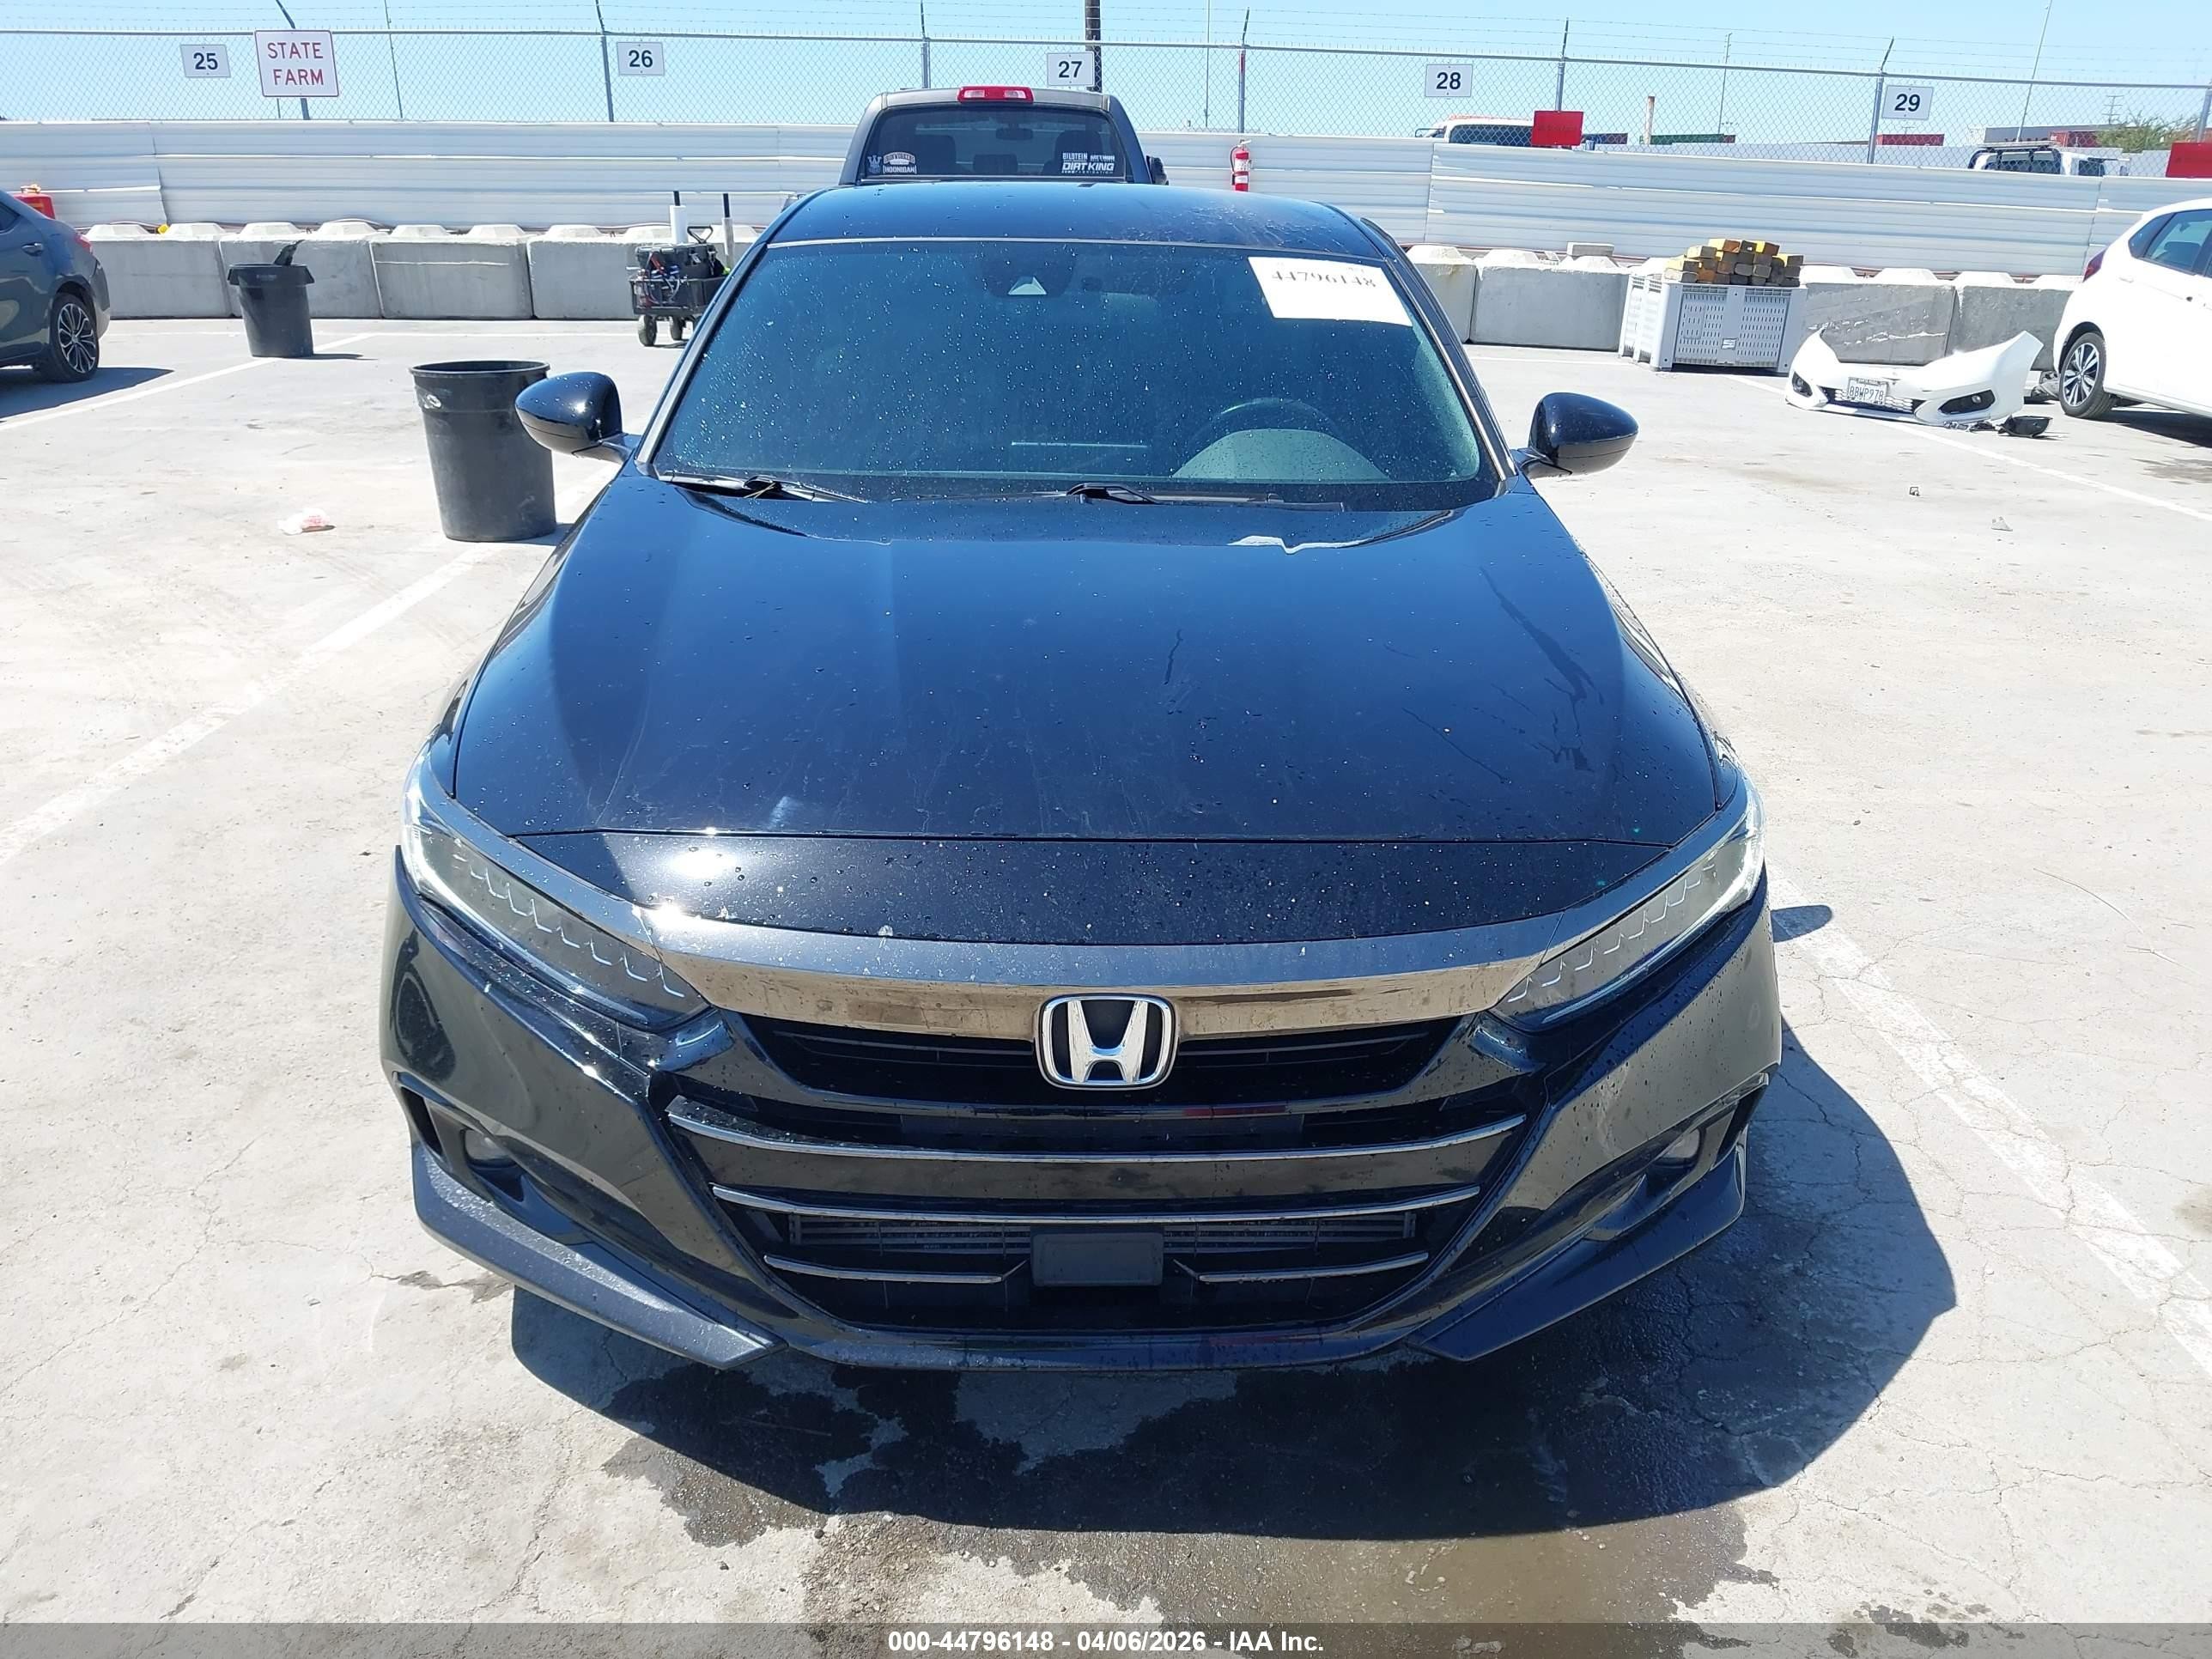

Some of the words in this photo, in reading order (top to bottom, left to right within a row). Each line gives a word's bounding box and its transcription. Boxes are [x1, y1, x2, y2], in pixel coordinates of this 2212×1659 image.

[267, 42, 324, 59] STATE
[629, 50, 653, 68] 26
[193, 52, 218, 70] 25
[1058, 61, 1083, 78] 27
[273, 69, 325, 86] FARM
[1436, 72, 1462, 90] 28
[1894, 94, 1921, 112] 29
[1087, 162, 1115, 171] KING
